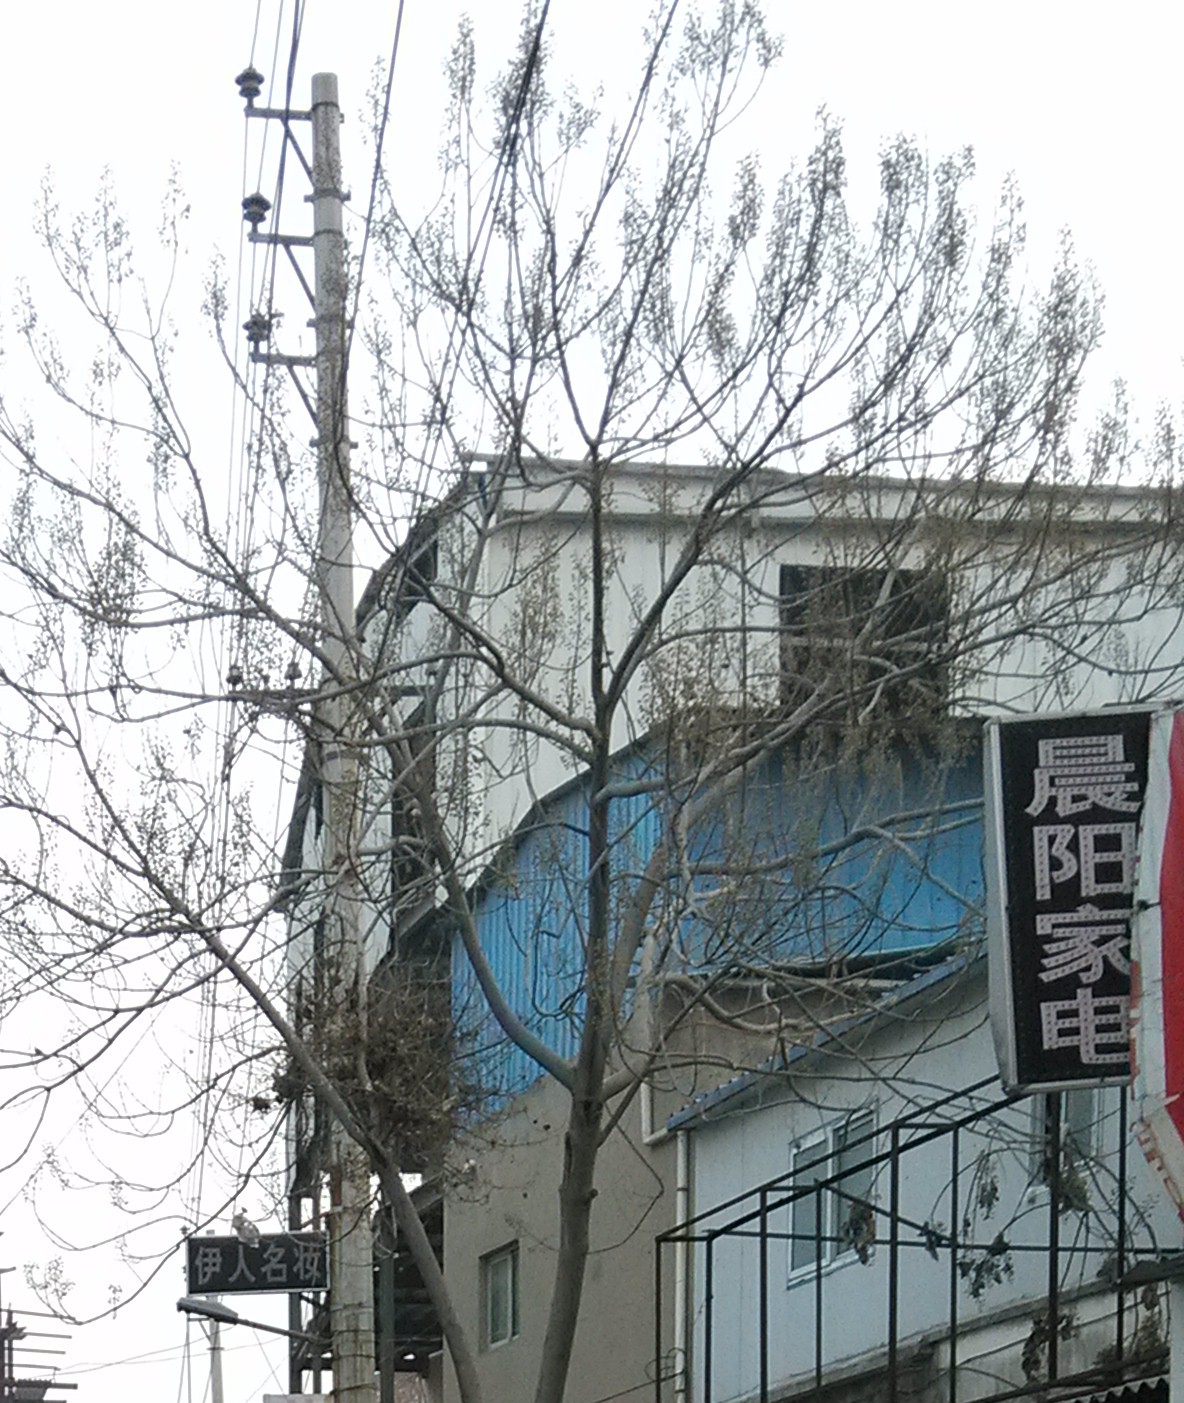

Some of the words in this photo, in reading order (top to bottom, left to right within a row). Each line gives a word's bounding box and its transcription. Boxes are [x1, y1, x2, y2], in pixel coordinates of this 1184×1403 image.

[1024, 734, 1142, 1066] 晨阳家电
[194, 1245, 323, 1286] 伊人名妆
